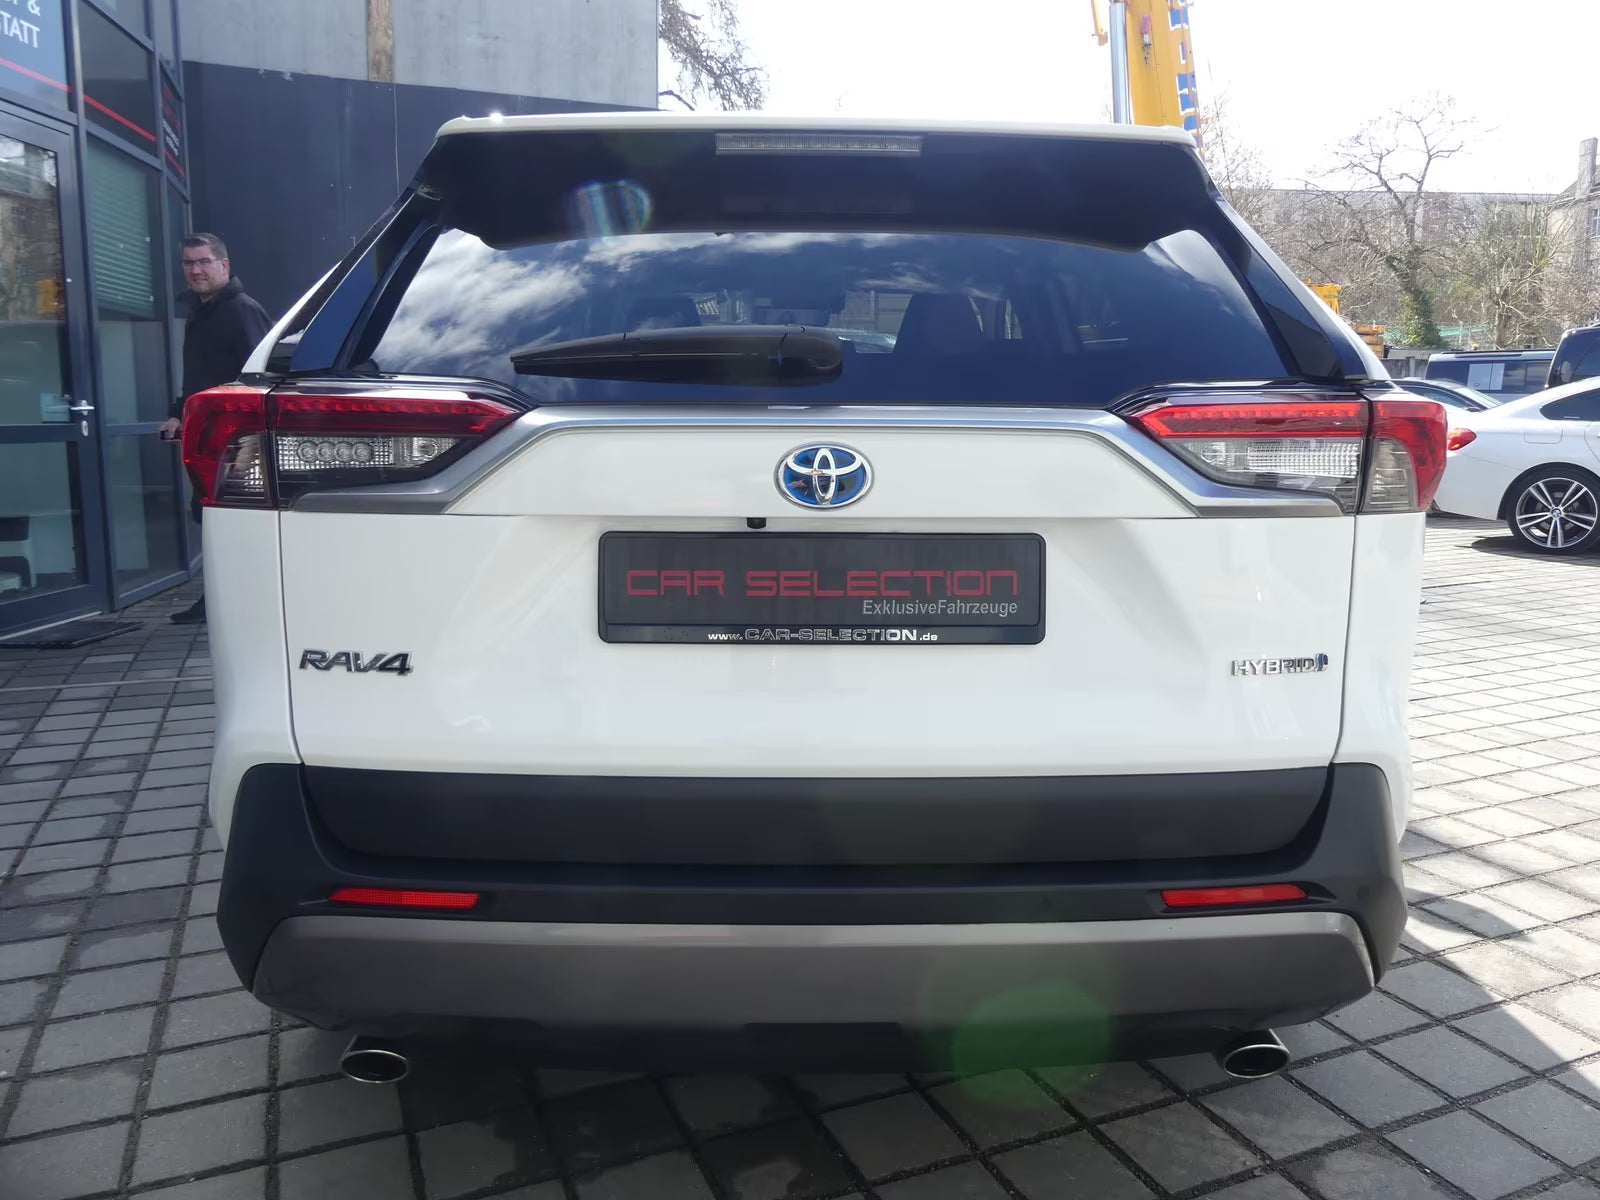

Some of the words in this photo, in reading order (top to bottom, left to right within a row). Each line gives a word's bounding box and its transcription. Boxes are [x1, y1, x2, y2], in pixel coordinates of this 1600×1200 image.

[0, 10, 41, 48] TATT
[626, 569, 725, 597] CAR
[745, 569, 1018, 597] SELECTION
[862, 599, 1019, 618] ExklusiveFahrzeuge
[298, 649, 413, 676] RAV4
[1231, 657, 1315, 676] HYBRID
